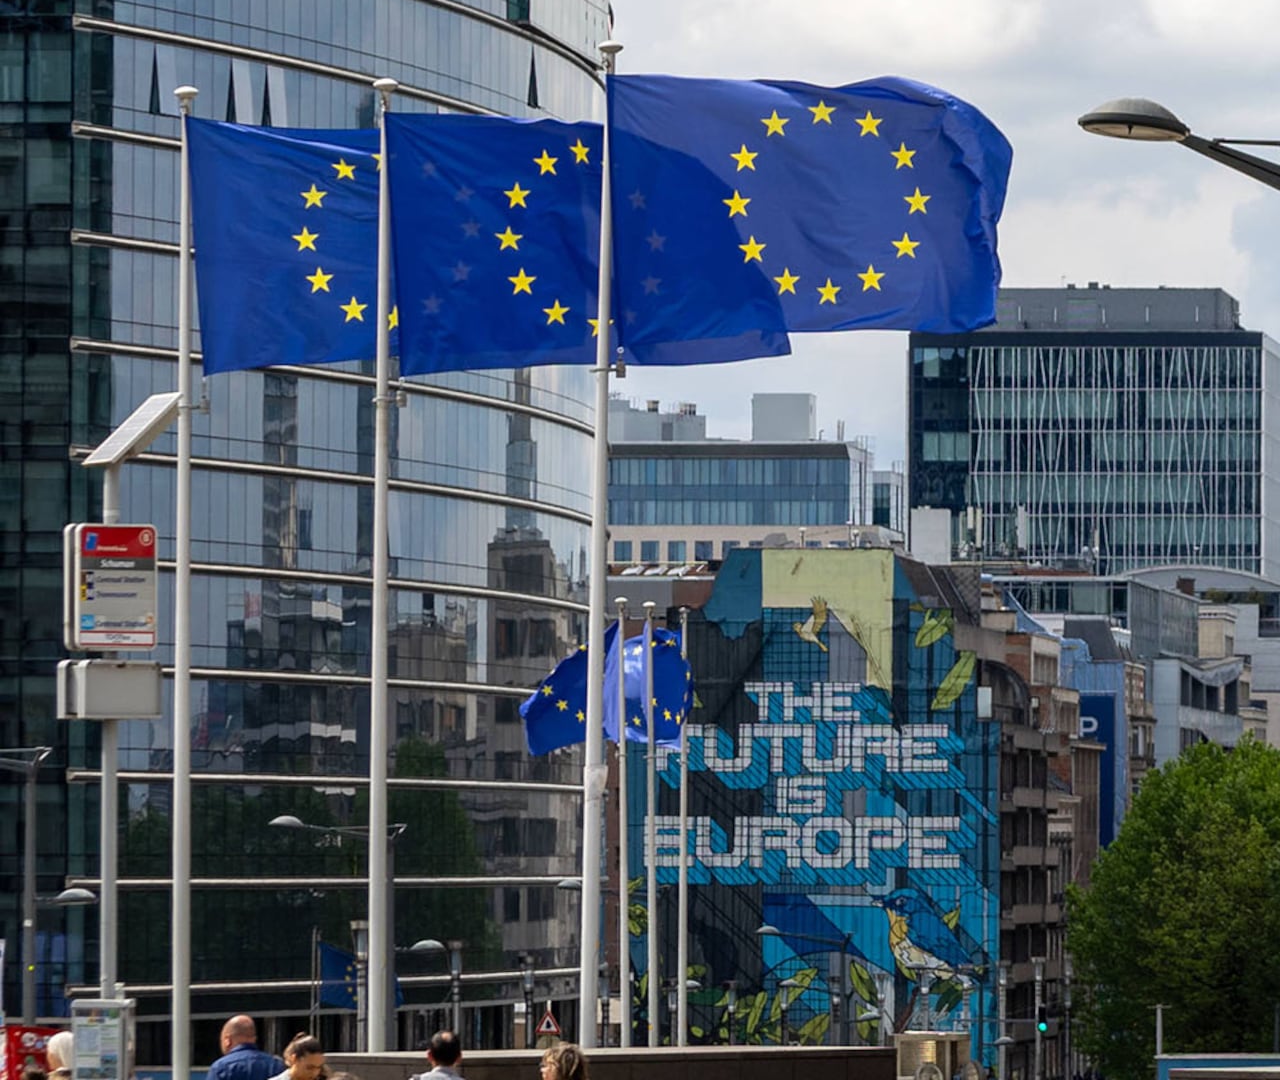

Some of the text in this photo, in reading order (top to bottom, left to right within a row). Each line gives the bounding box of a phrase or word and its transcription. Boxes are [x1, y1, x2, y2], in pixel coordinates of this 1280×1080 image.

[744, 682, 861, 721] THE
[776, 776, 827, 814] IS
[643, 816, 960, 869] EUROPE
